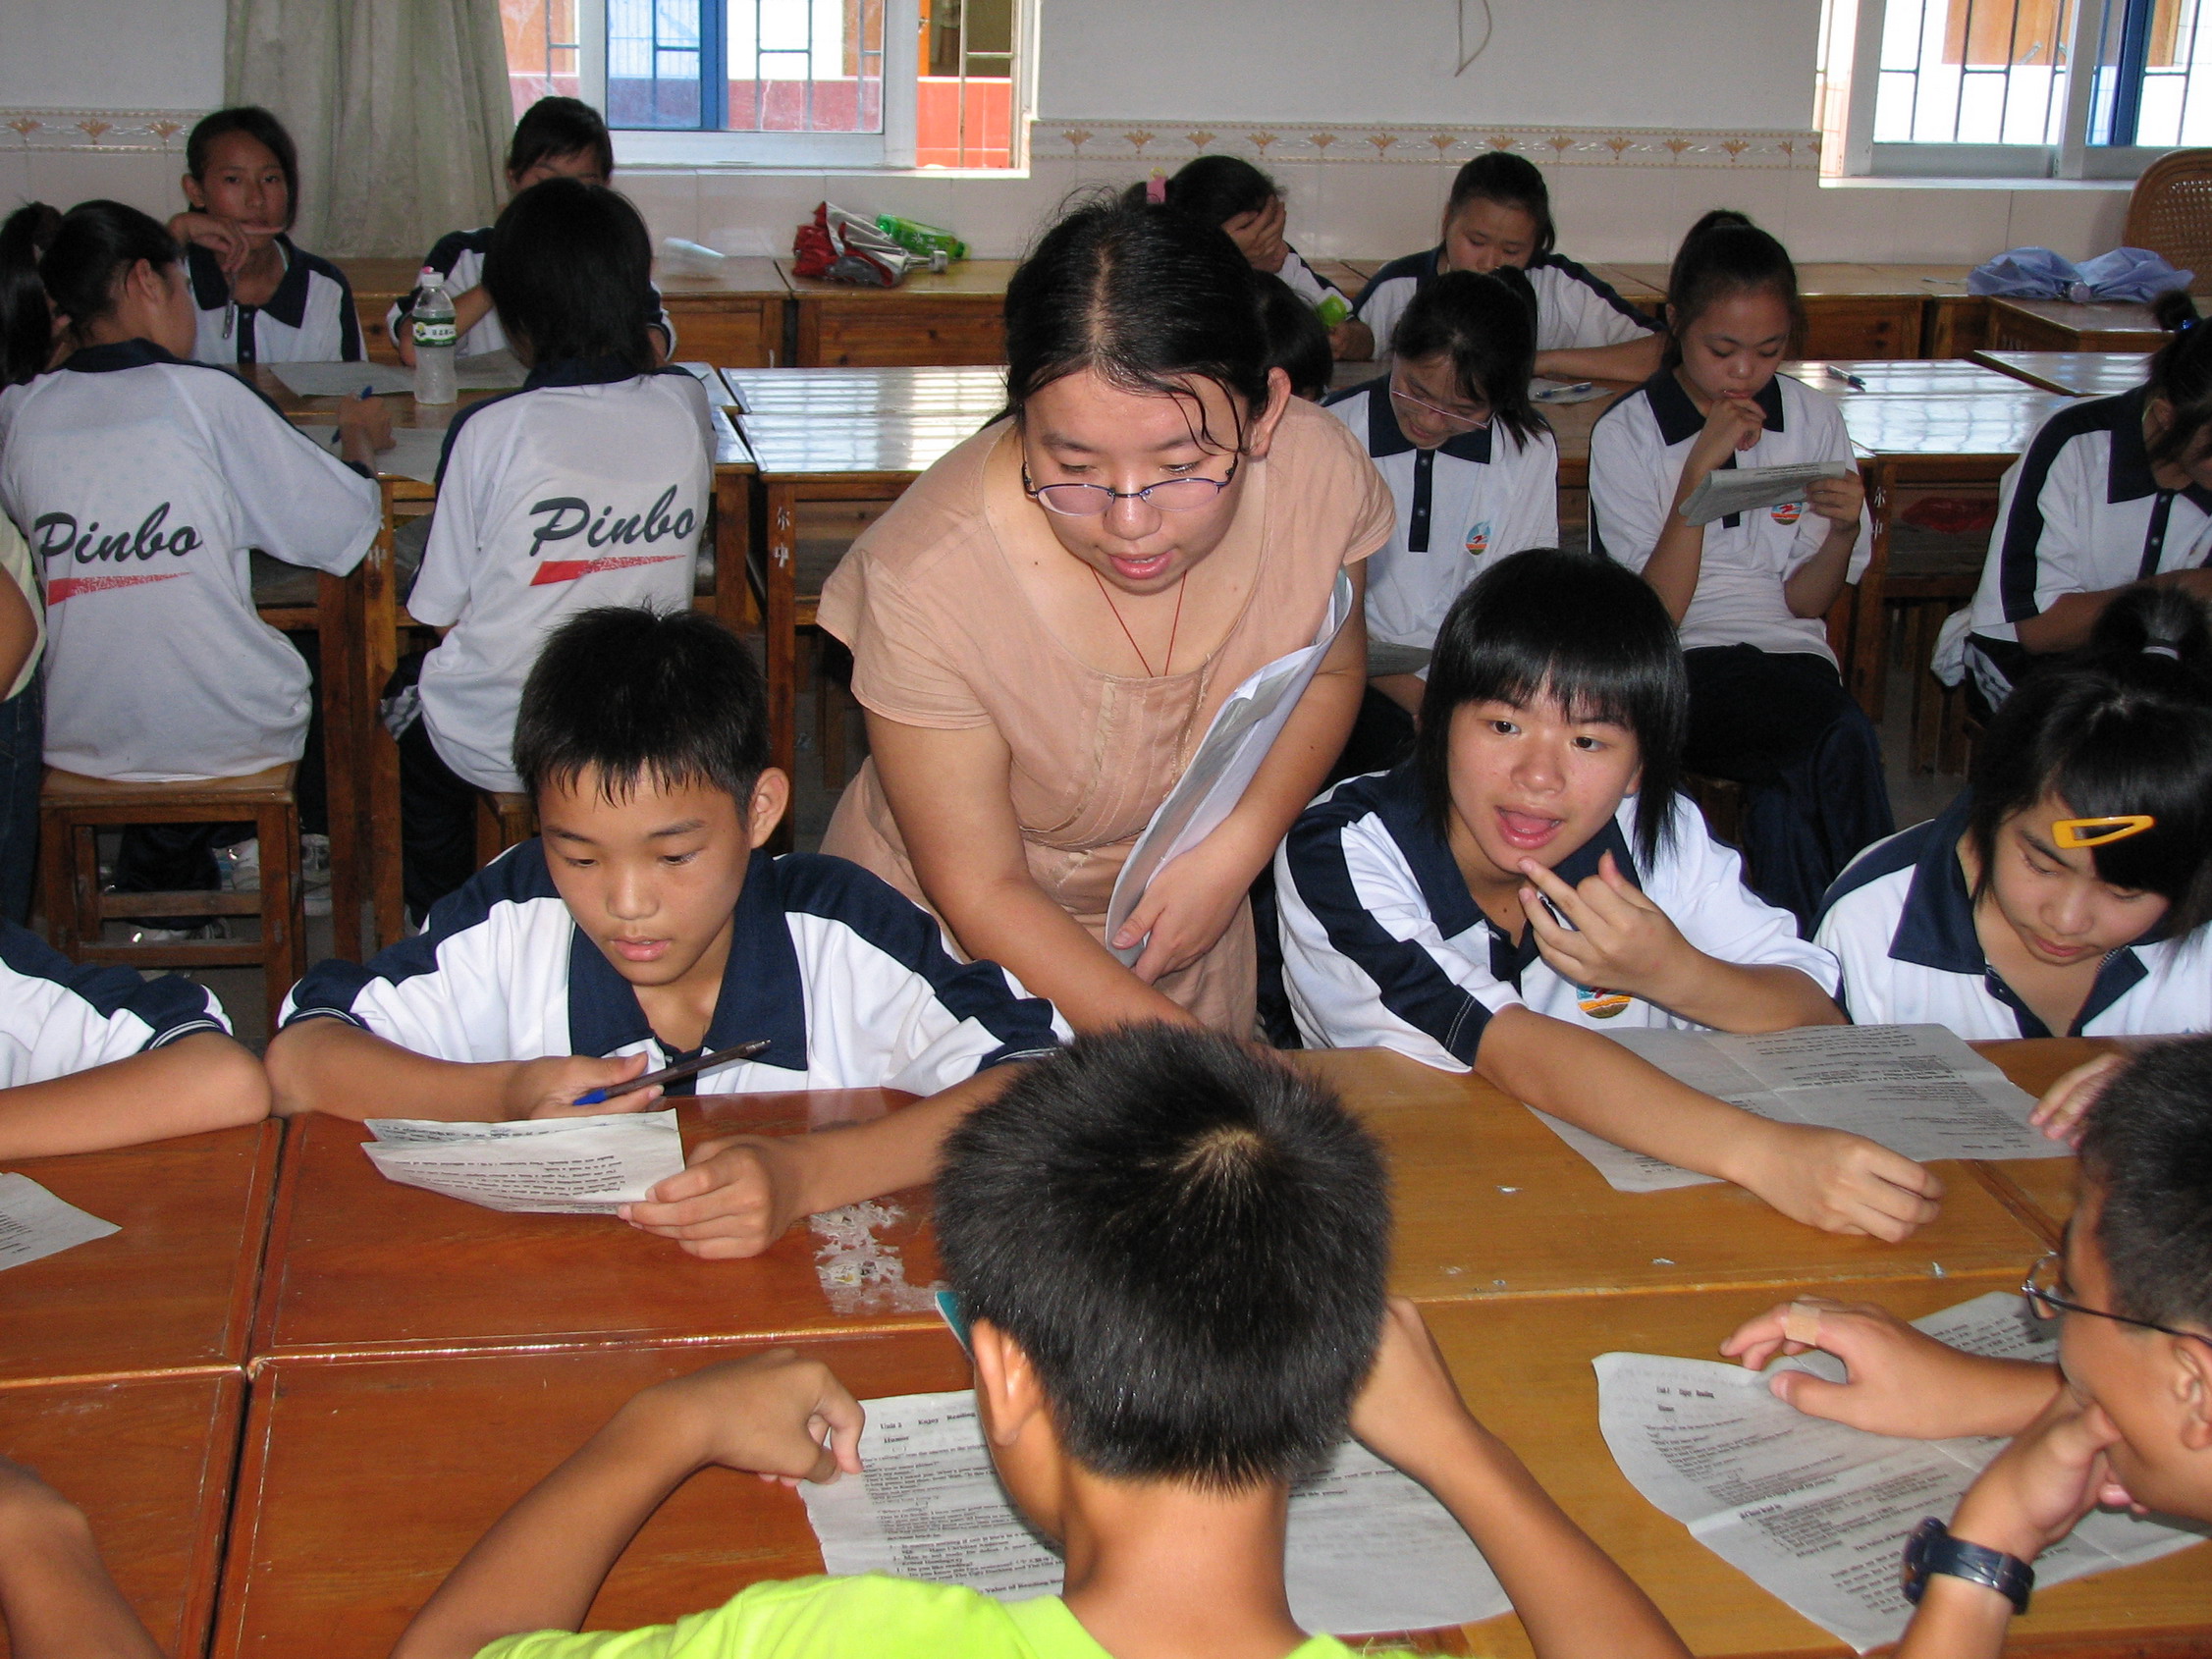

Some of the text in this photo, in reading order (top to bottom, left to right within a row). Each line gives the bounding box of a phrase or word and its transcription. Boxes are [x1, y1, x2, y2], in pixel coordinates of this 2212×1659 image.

[34, 502, 203, 571] Pinbo
[528, 484, 697, 557] Pinbo
[946, 1412, 976, 1420] Reading
